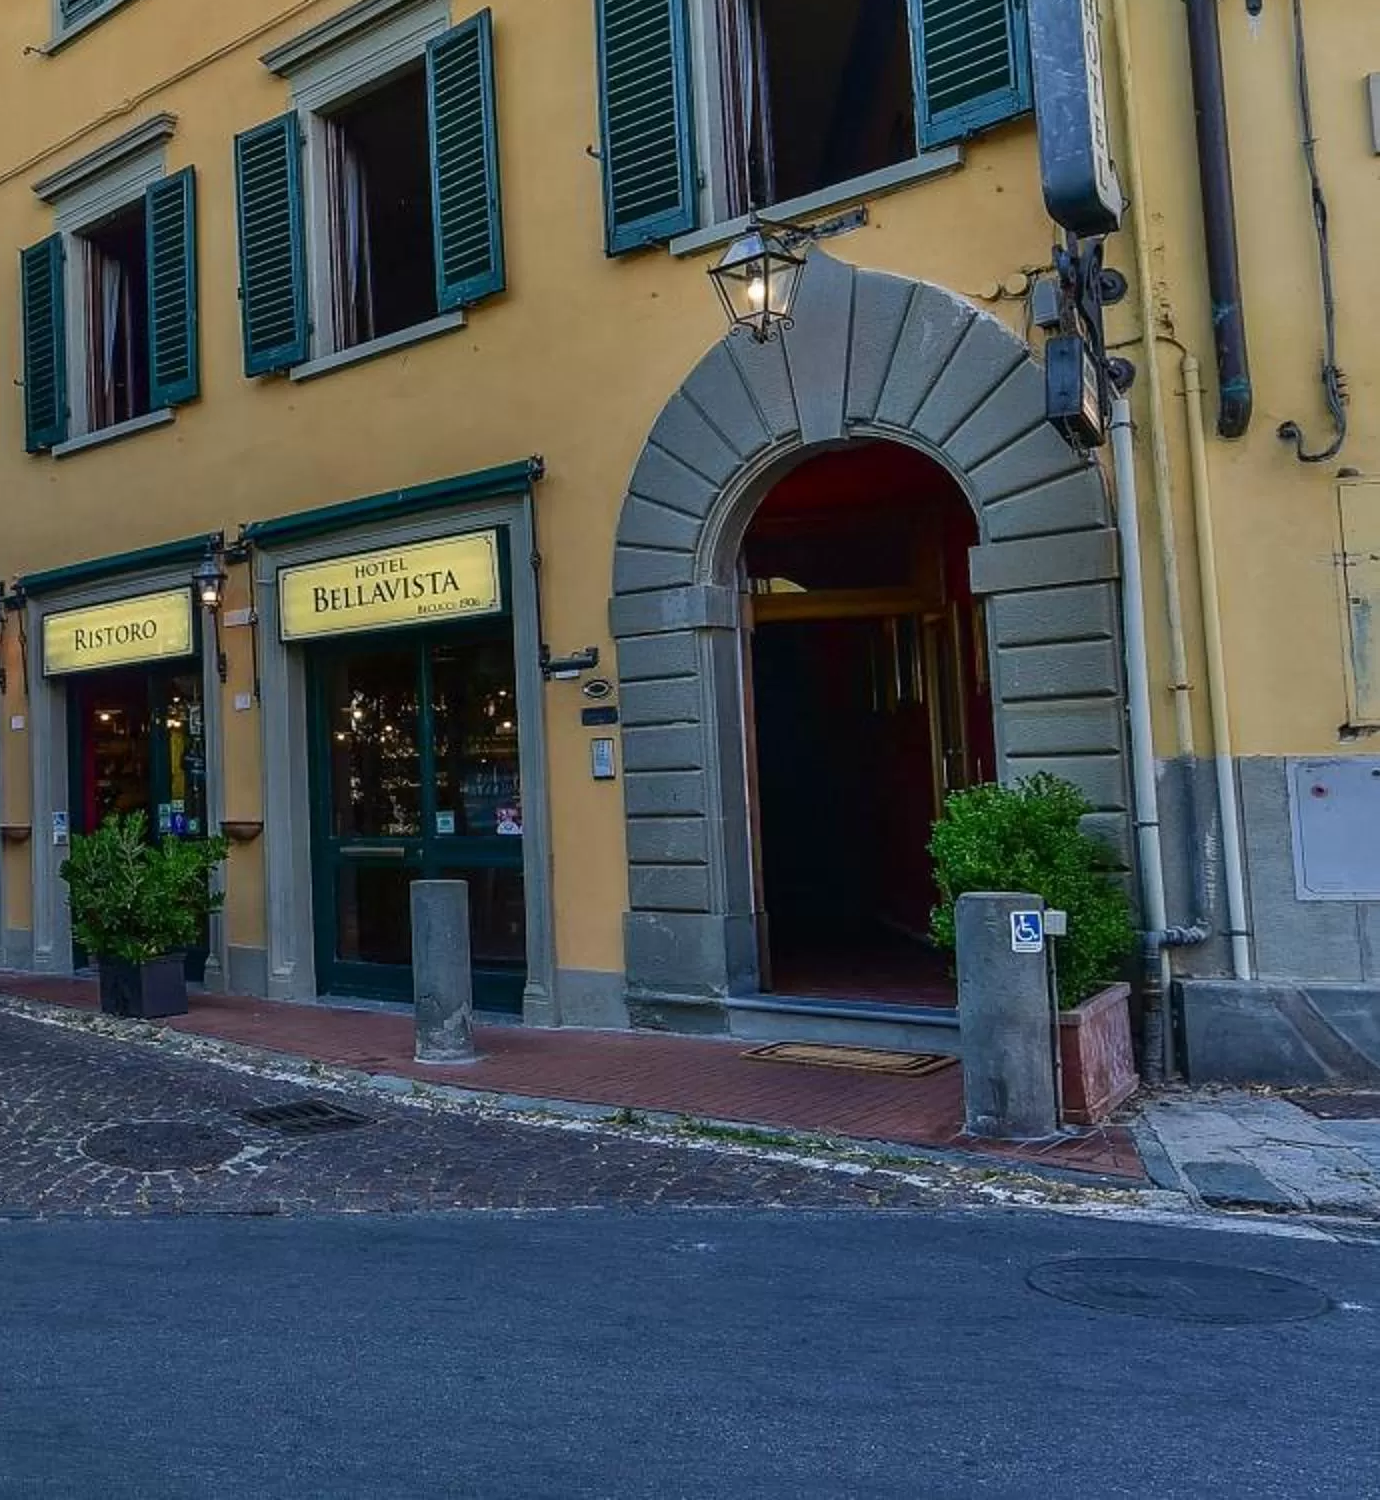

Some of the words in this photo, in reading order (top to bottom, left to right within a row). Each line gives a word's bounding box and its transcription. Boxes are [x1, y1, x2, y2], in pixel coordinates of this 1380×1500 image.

[355, 557, 408, 579] HOTEL
[313, 569, 460, 613] BELLAVISTA
[75, 619, 157, 651] RISTORO
